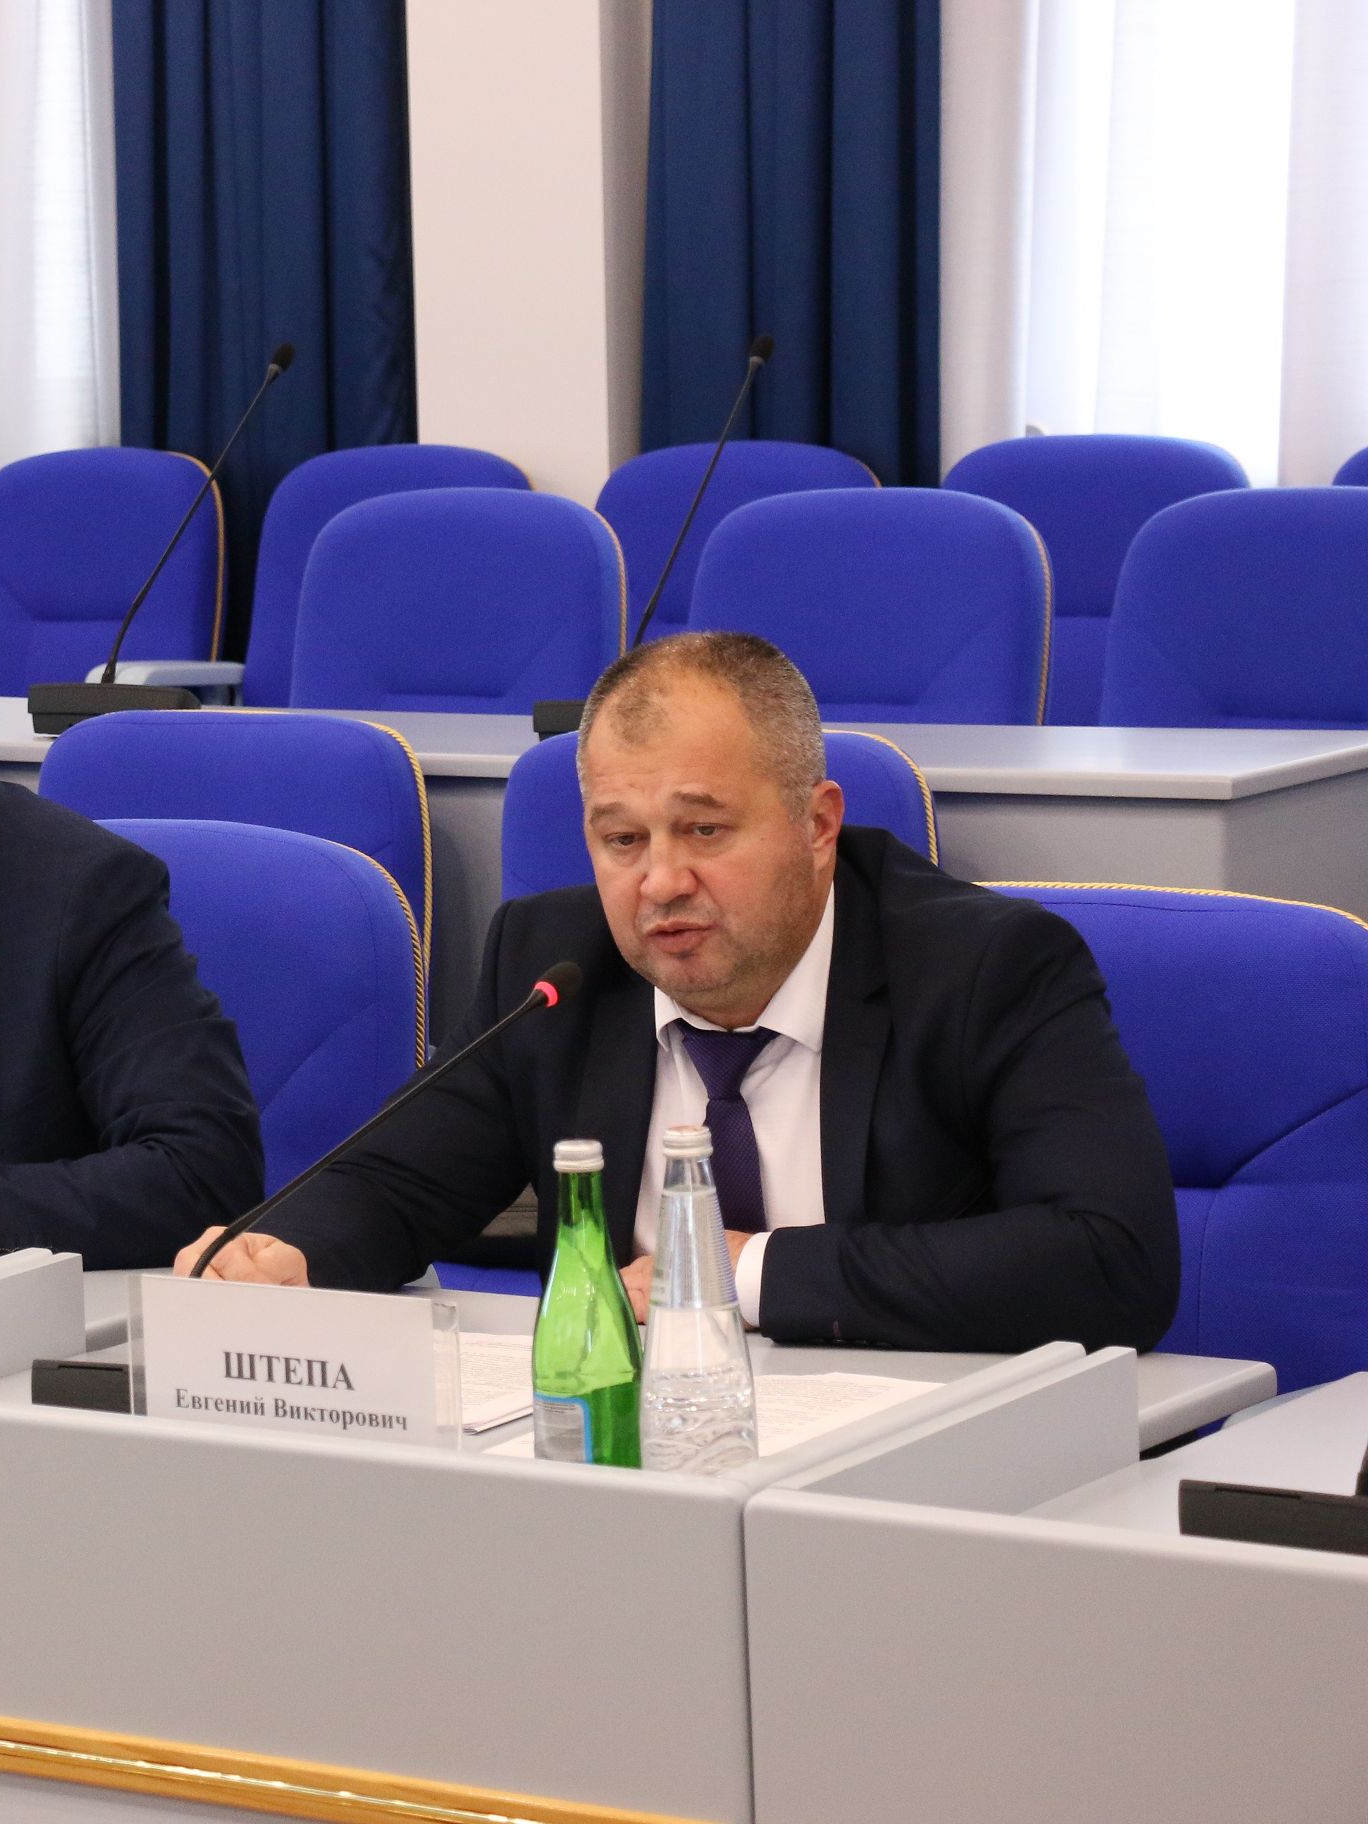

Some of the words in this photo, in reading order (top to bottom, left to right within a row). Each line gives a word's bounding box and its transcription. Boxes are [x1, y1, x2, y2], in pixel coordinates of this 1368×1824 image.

[223, 1351, 355, 1391] ШТЕПА
[175, 1388, 266, 1417] Евгений
[274, 1398, 408, 1430] Викторович
